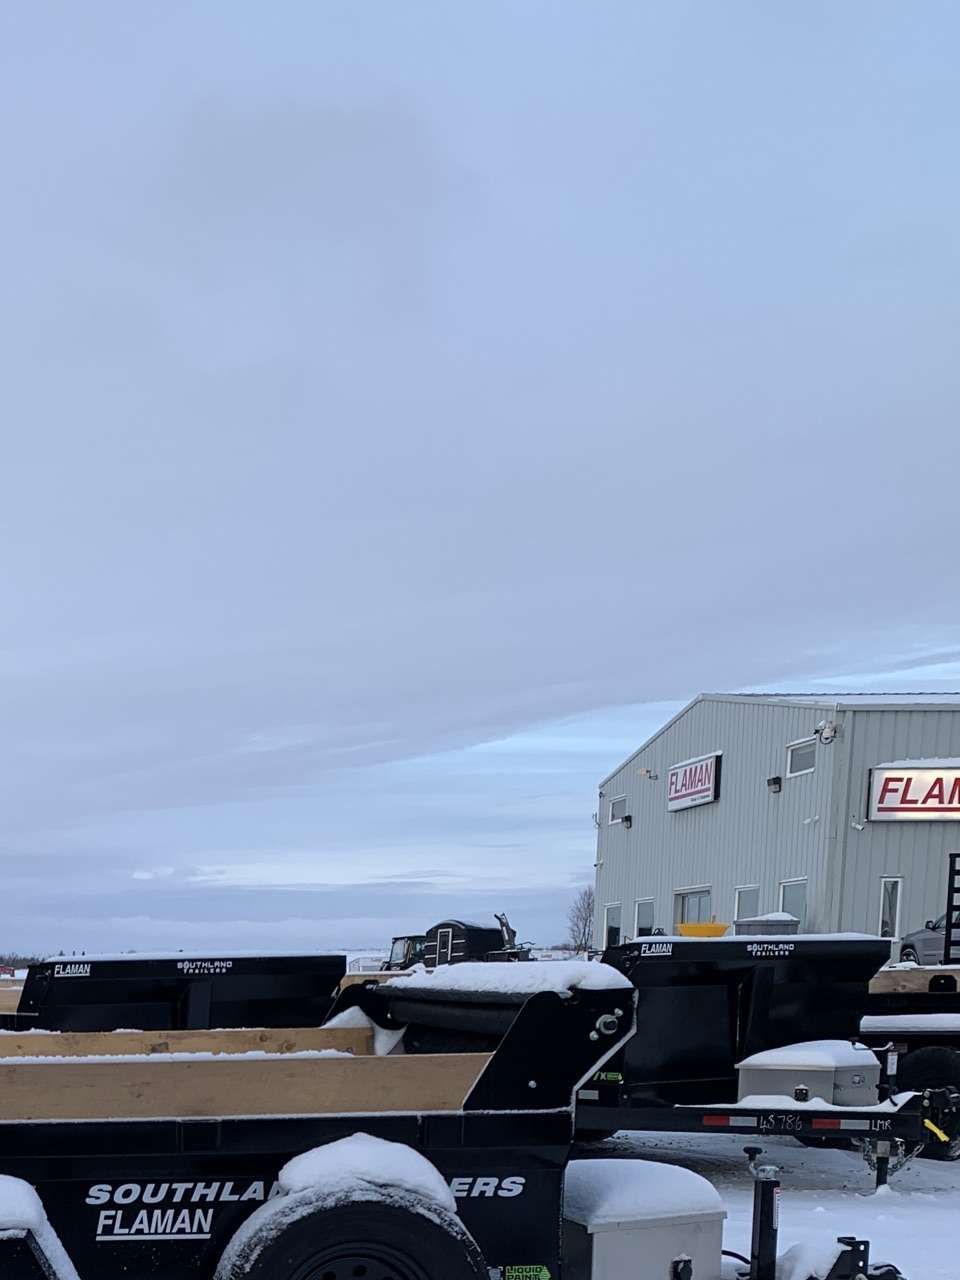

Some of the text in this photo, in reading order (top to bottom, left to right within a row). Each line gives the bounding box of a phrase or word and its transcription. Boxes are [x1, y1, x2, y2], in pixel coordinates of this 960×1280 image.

[669, 760, 713, 796] FLAMAN
[641, 943, 672, 955] FLAMAN
[746, 943, 794, 951] SOUTHLAND
[54, 963, 91, 975] FLAMAN
[176, 961, 233, 969] SOUTHLAND
[450, 1176, 526, 1197] ERS
[96, 1208, 214, 1235] FLAMAN
